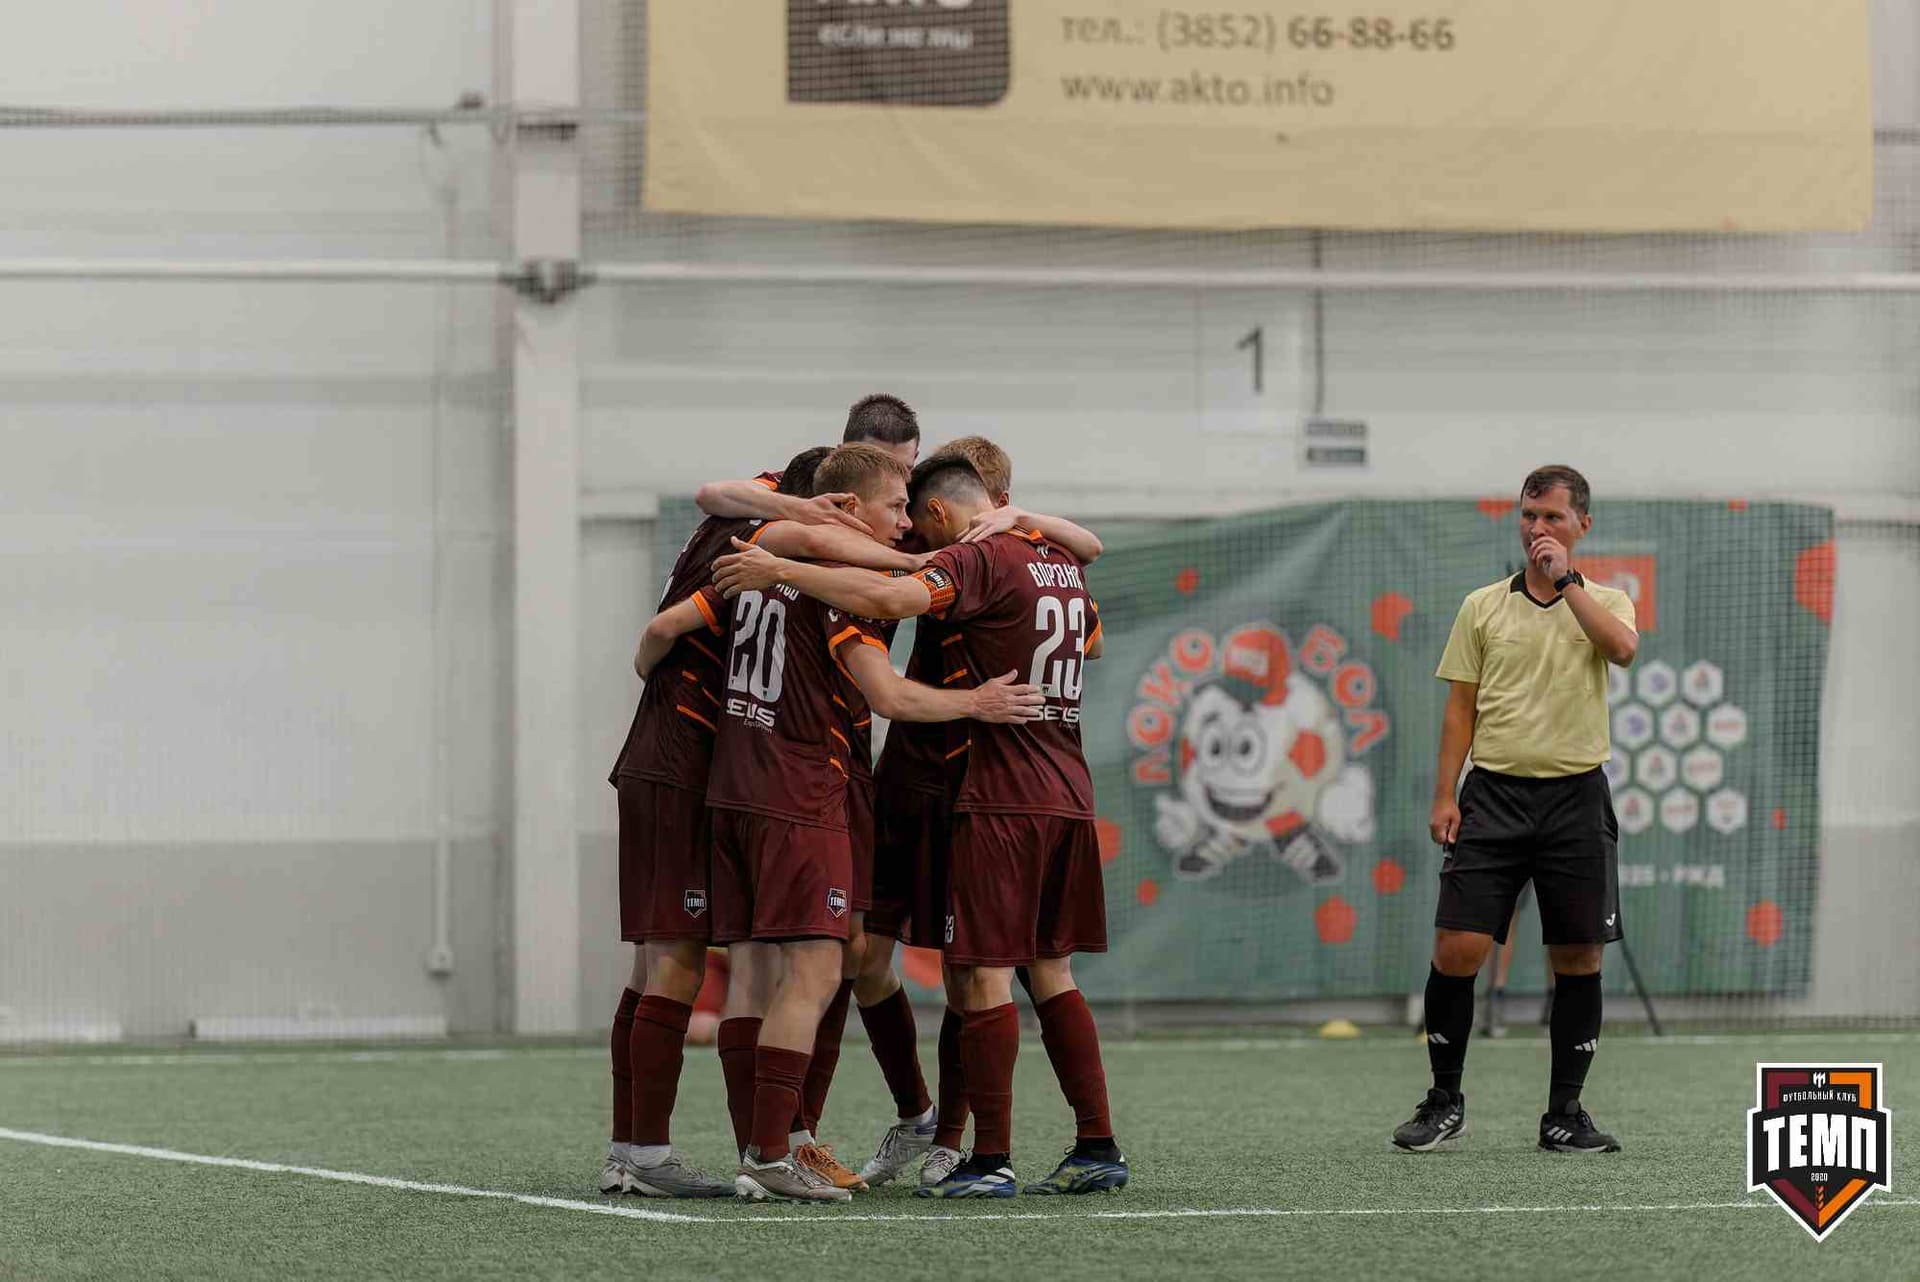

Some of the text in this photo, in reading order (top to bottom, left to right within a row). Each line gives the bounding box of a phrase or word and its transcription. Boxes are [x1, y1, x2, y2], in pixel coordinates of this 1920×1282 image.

[1155, 11, 1277, 55] (3852)
[1287, 16, 1455, 50] 66-88-66
[1060, 69, 1336, 107] www.akto.info
[1235, 325, 1263, 393] 1
[727, 589, 787, 703] 20
[1028, 595, 1085, 700] 23
